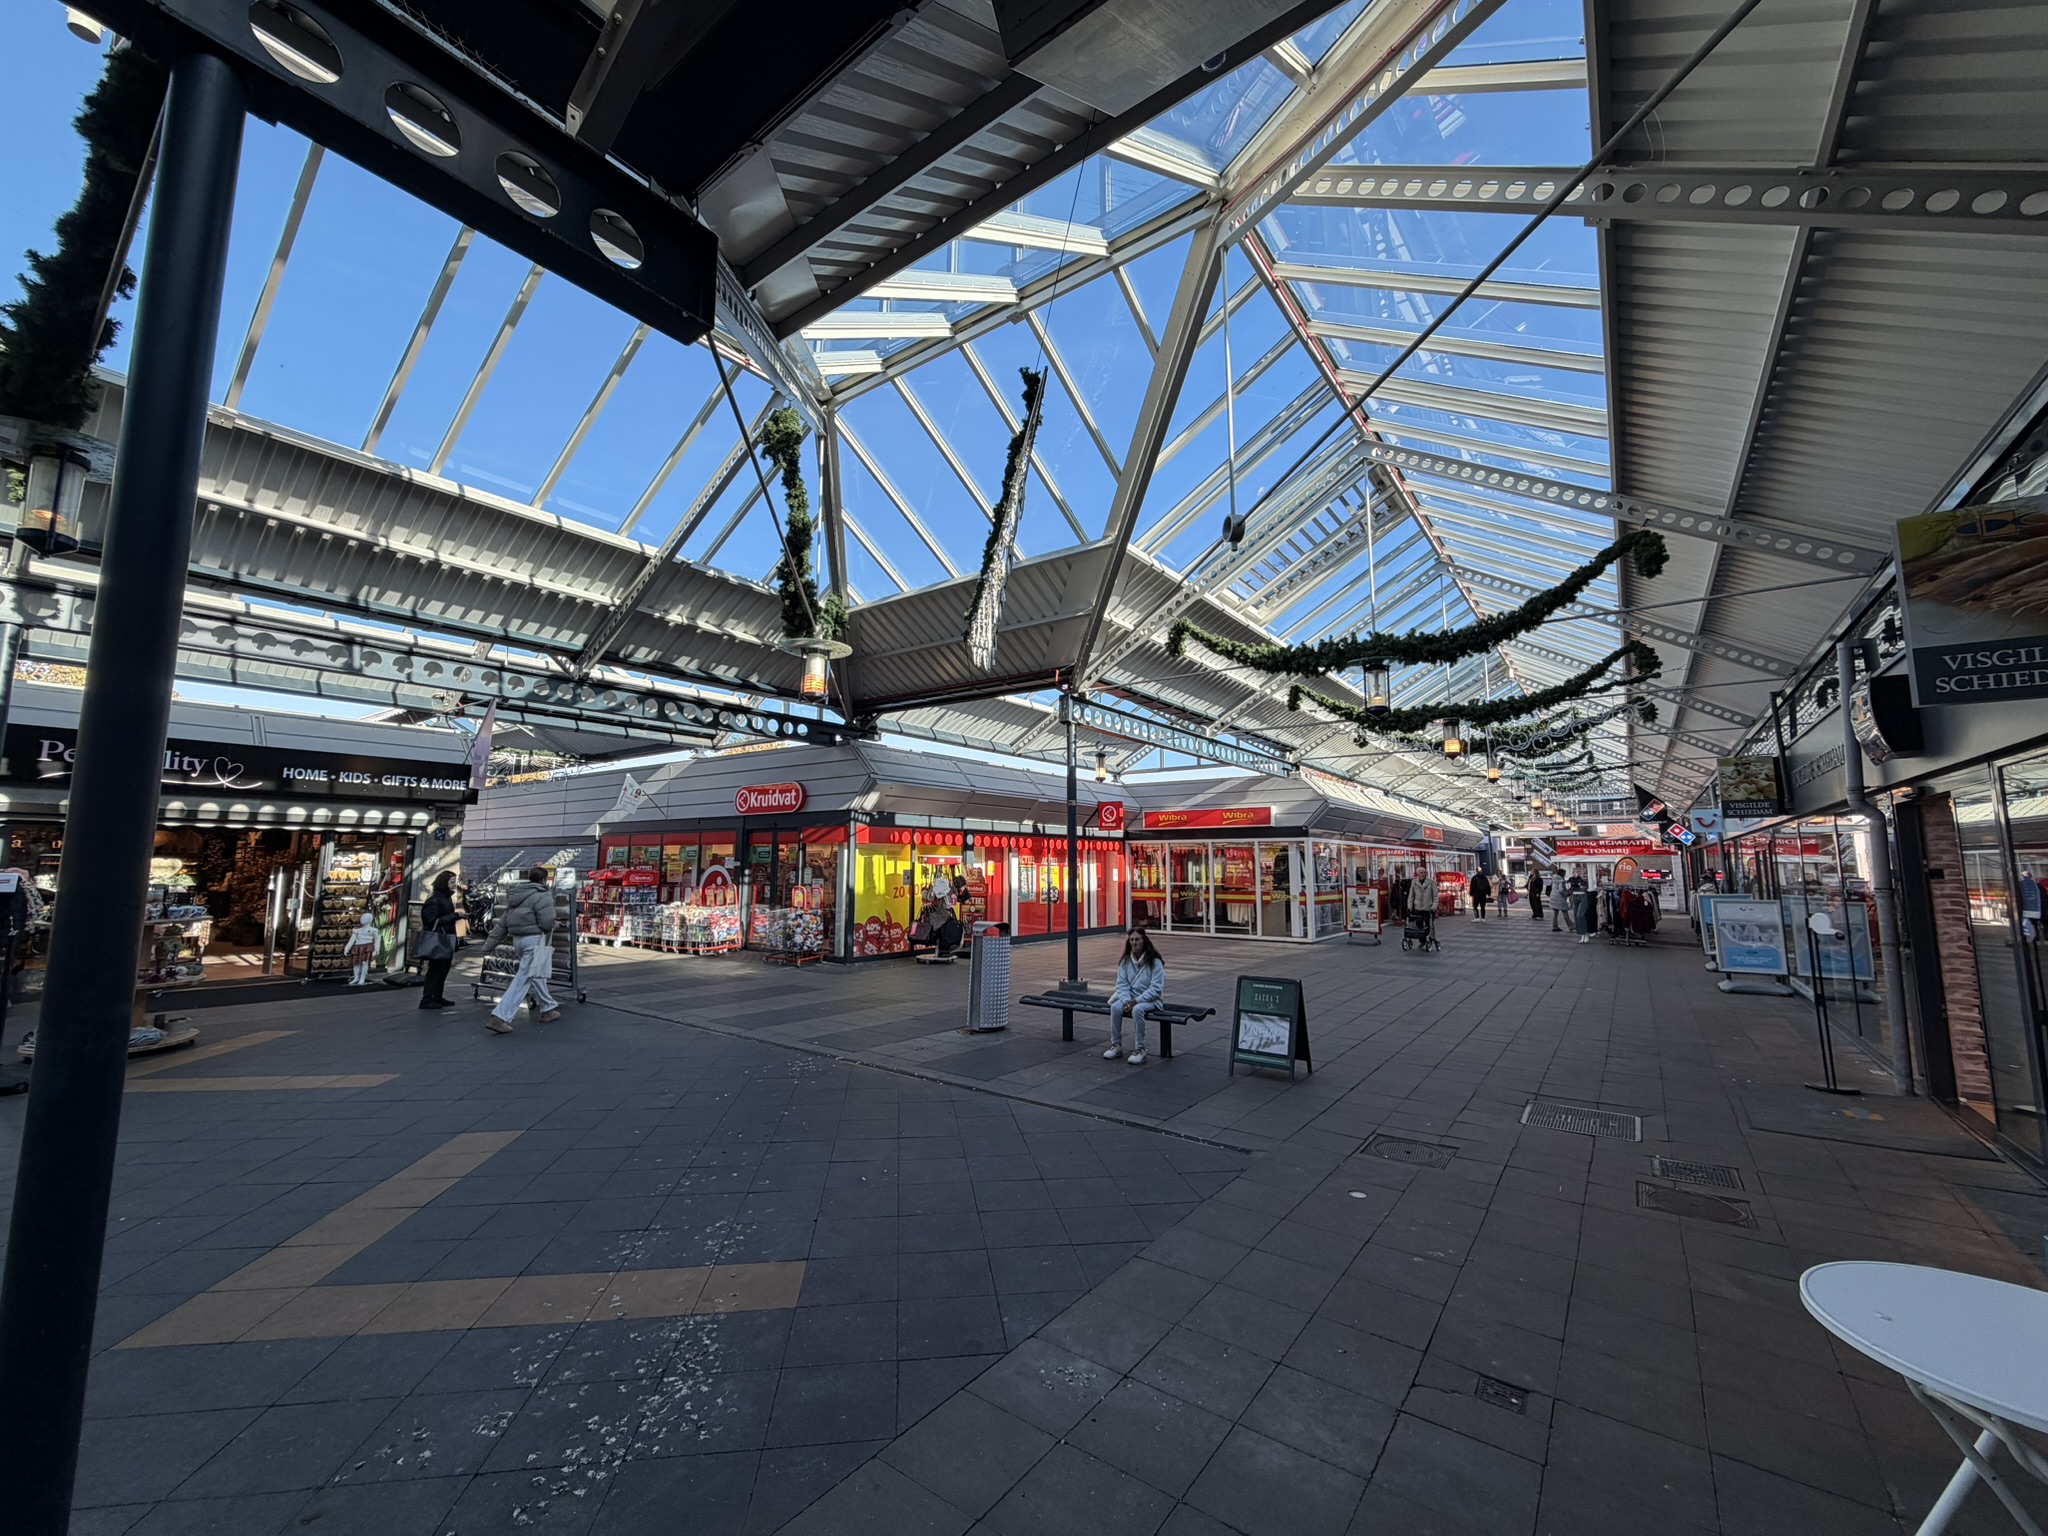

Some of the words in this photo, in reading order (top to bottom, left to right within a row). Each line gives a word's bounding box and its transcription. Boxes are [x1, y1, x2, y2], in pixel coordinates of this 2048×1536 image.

[282, 767, 328, 781] HOME
[338, 771, 371, 785] KIDS
[382, 774, 417, 788] GIFTS
[420, 777, 430, 789] &
[431, 778, 467, 791] MORE
[750, 789, 797, 808] Kruidvat
[1728, 801, 1771, 809] VISGILDE
[1158, 812, 1188, 821] Wibra
[1222, 810, 1254, 819] Wibra
[1618, 862, 1633, 871] ria
